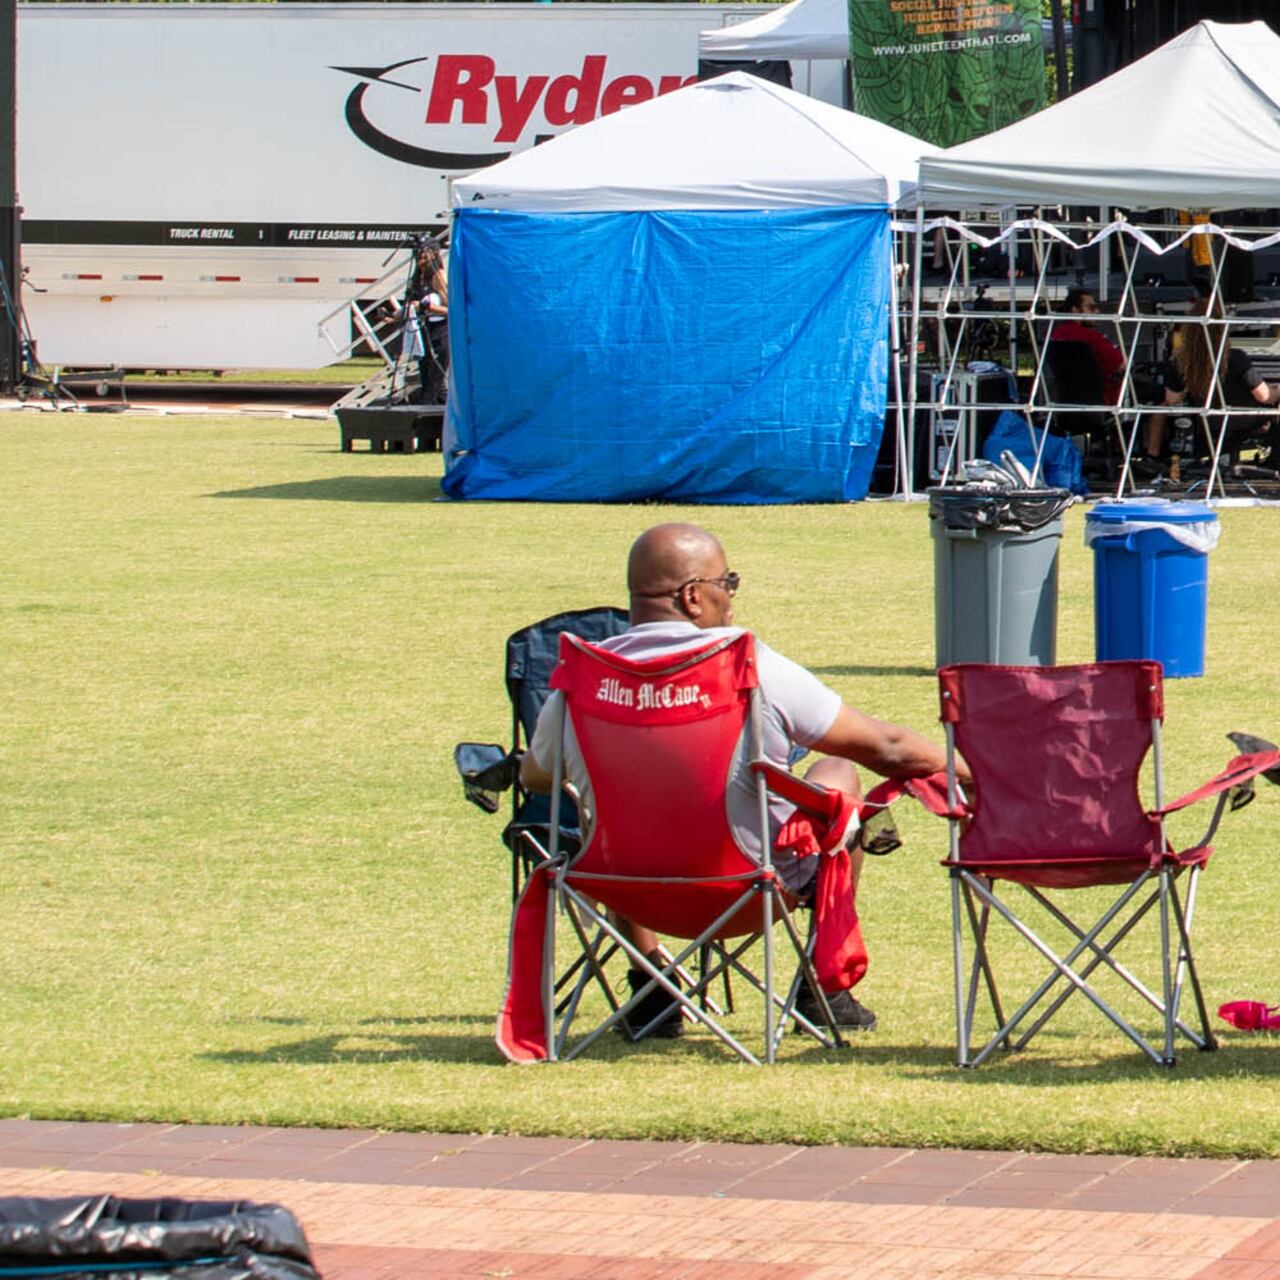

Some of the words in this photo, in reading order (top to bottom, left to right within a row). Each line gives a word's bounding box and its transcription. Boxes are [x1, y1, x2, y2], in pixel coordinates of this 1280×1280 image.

[872, 33, 1031, 56] WWW.JUNETEENTHATL.COM
[170, 228, 199, 239] TRUCK
[201, 228, 235, 239] RENTAL
[288, 229, 316, 241] FLEET
[317, 229, 355, 241] LEASING
[595, 677, 634, 707] Allen
